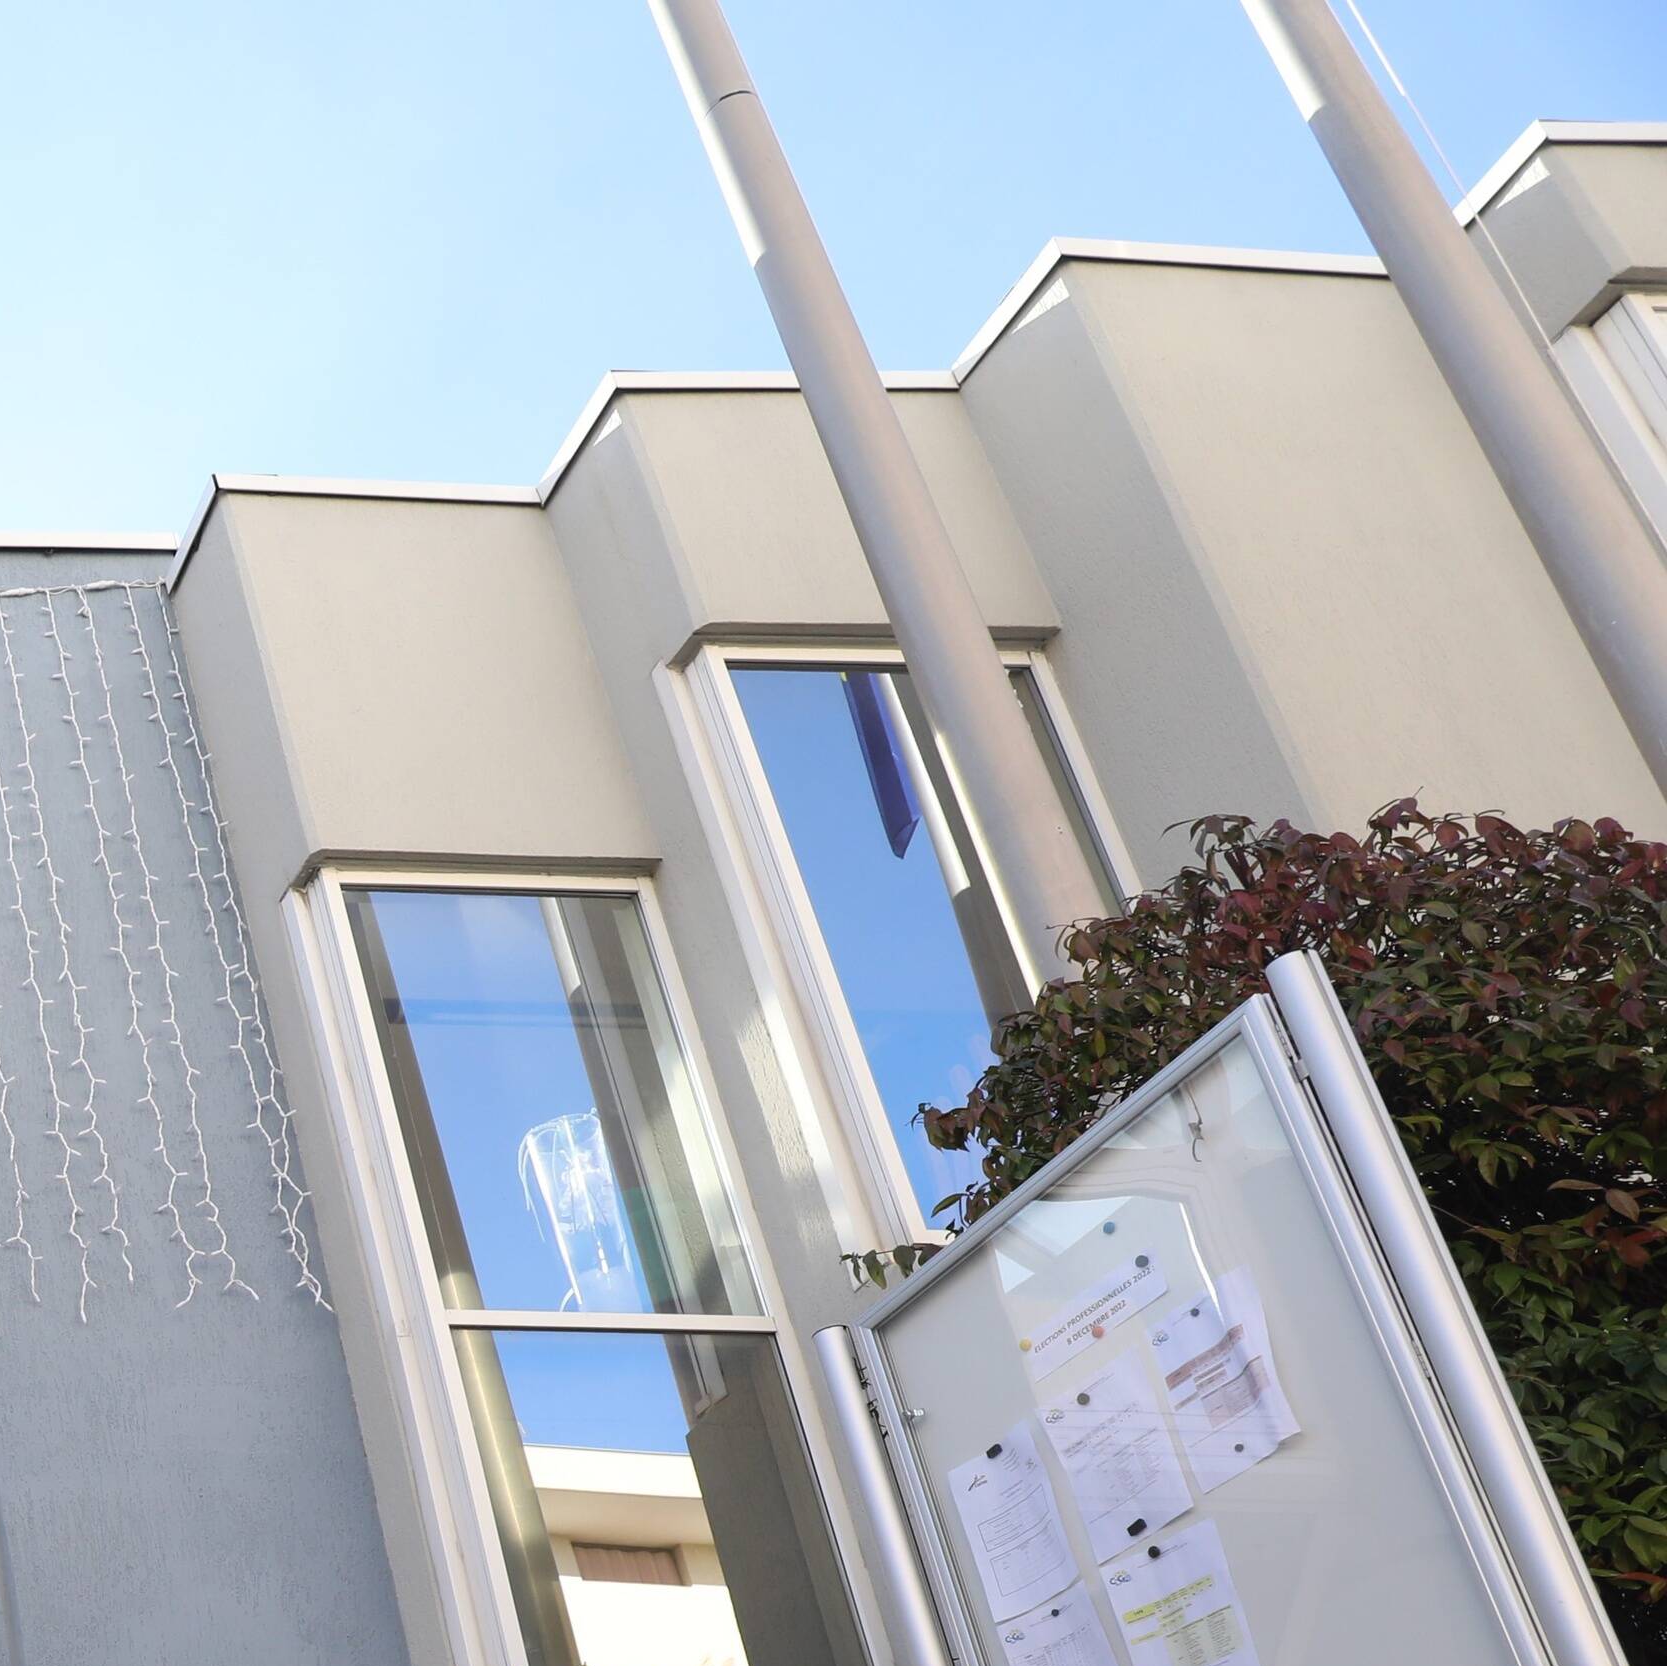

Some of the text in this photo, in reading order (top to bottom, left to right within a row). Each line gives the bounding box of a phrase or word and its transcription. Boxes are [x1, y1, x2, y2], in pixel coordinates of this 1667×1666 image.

[1034, 1326, 1066, 1353] ELECTIONS
[1067, 1279, 1132, 1328] PROFESSIONNELLES
[1132, 1267, 1151, 1283] 2022
[1073, 1312, 1109, 1341] DECEMBRE
[1109, 1299, 1127, 1317] 2022
